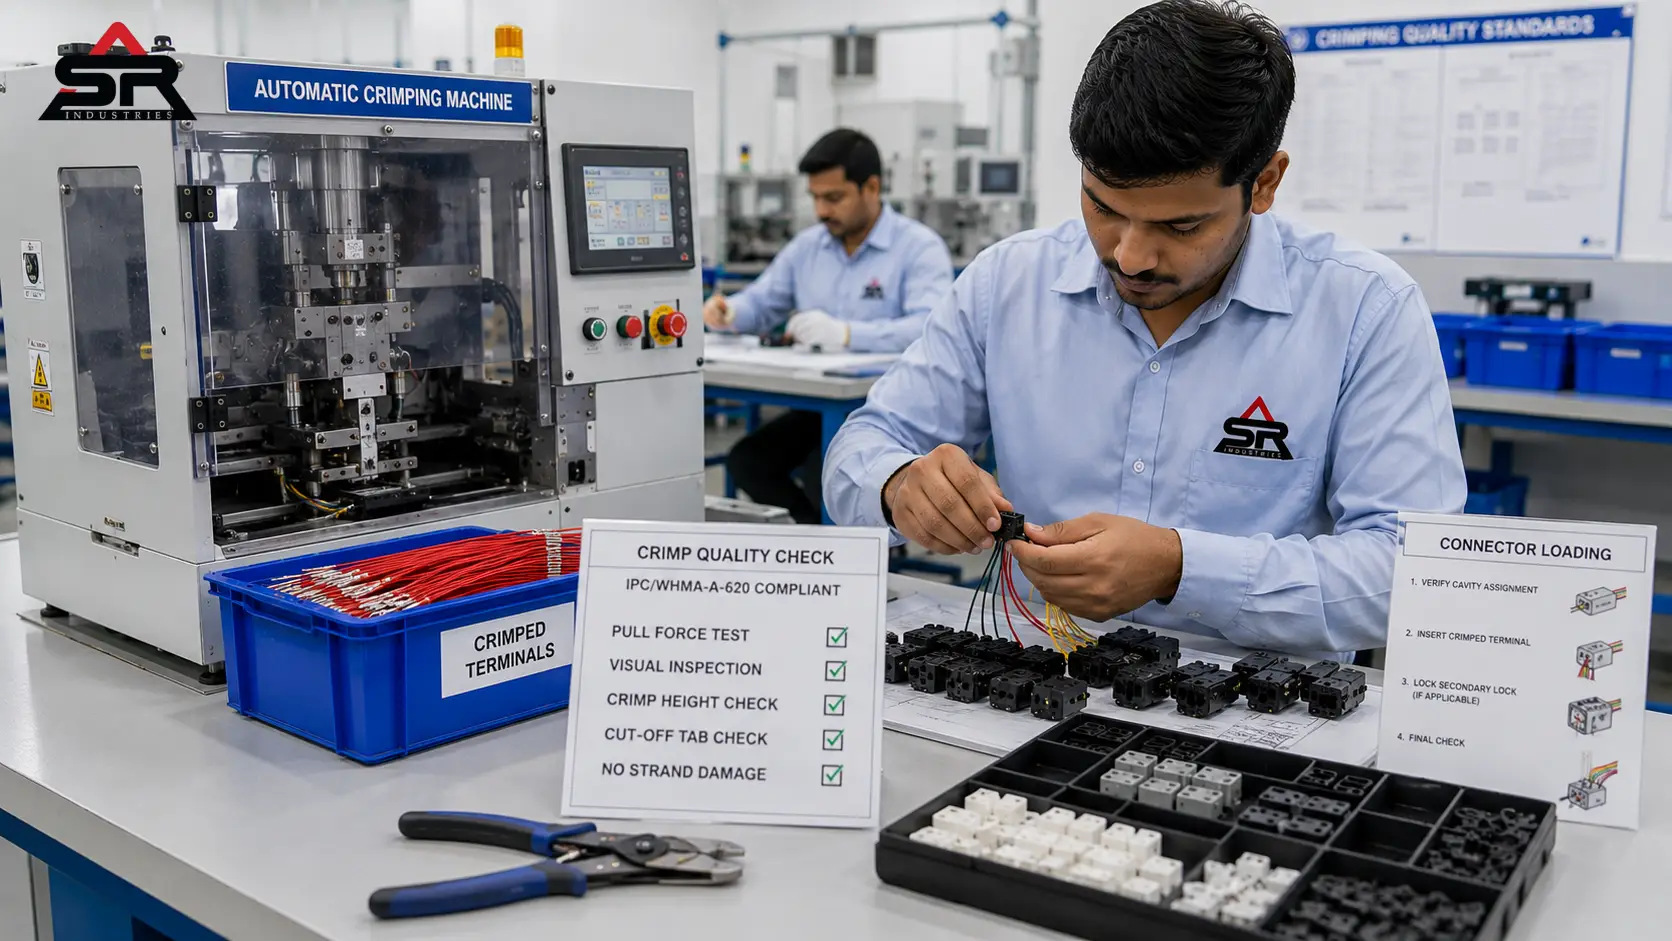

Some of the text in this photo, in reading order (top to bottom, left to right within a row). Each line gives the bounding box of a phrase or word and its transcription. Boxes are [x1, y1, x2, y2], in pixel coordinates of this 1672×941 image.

[1315, 15, 1595, 49] CRIMPING QUALITY STANDARDS
[254, 78, 513, 111] AUTOMATIC CRIMPING MACHINE
[1213, 416, 1294, 460] SR
[1223, 447, 1283, 459] INDUSTRIES
[637, 545, 834, 565] CRIMP QUALITY CHECK
[1440, 537, 1611, 561] CONNECTOR LOADING
[625, 578, 841, 597] IPC/WHMA-A-620 COMPLIANT
[1411, 578, 1539, 594] 1. VERIFY CAVITY ASSIGNMENT
[474, 621, 546, 652] CRIMPED
[611, 625, 750, 642] PULL FORCE TEST
[1405, 629, 1531, 647] 2. INSERT CRIMPED TERMINAL
[465, 642, 555, 678] TERMINALS
[610, 659, 763, 676] VISUAL INSPECTION
[1401, 678, 1517, 696] 3. LOCK SECONDARY LOCK
[606, 693, 778, 711] CRIMP HEIGHT CHECK
[1412, 690, 1480, 706] (IF APPLICABLE)
[604, 728, 768, 746] CUT-OFF TAB CHECK
[1397, 733, 1465, 747] 4. FINAL CHECK
[602, 763, 767, 781] NO STRAND DAMAGE
